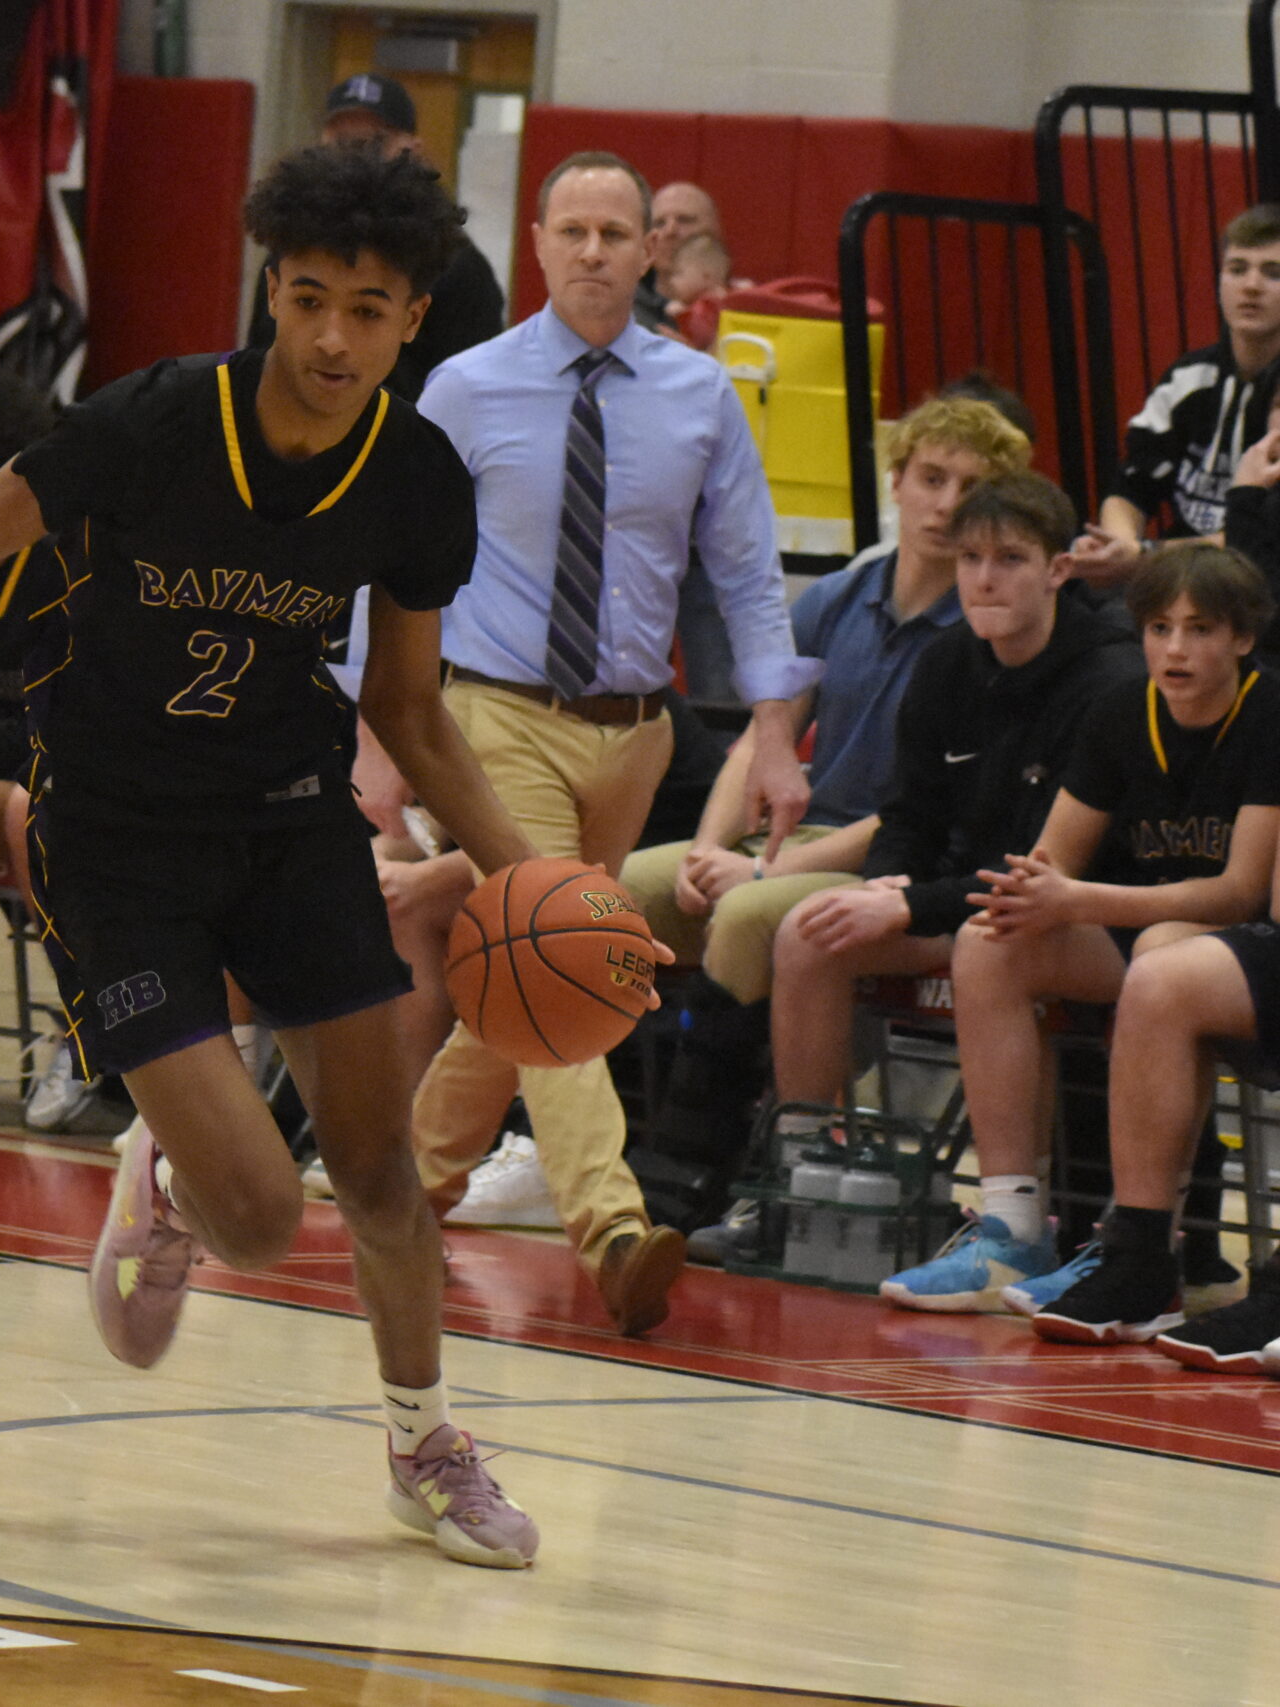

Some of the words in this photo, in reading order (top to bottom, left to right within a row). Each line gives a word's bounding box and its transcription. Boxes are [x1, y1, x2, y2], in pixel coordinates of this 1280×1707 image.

[134, 560, 346, 628] BAYMEN
[165, 629, 255, 718] 2
[605, 944, 655, 981] LEGA
[96, 969, 167, 1031] HB
